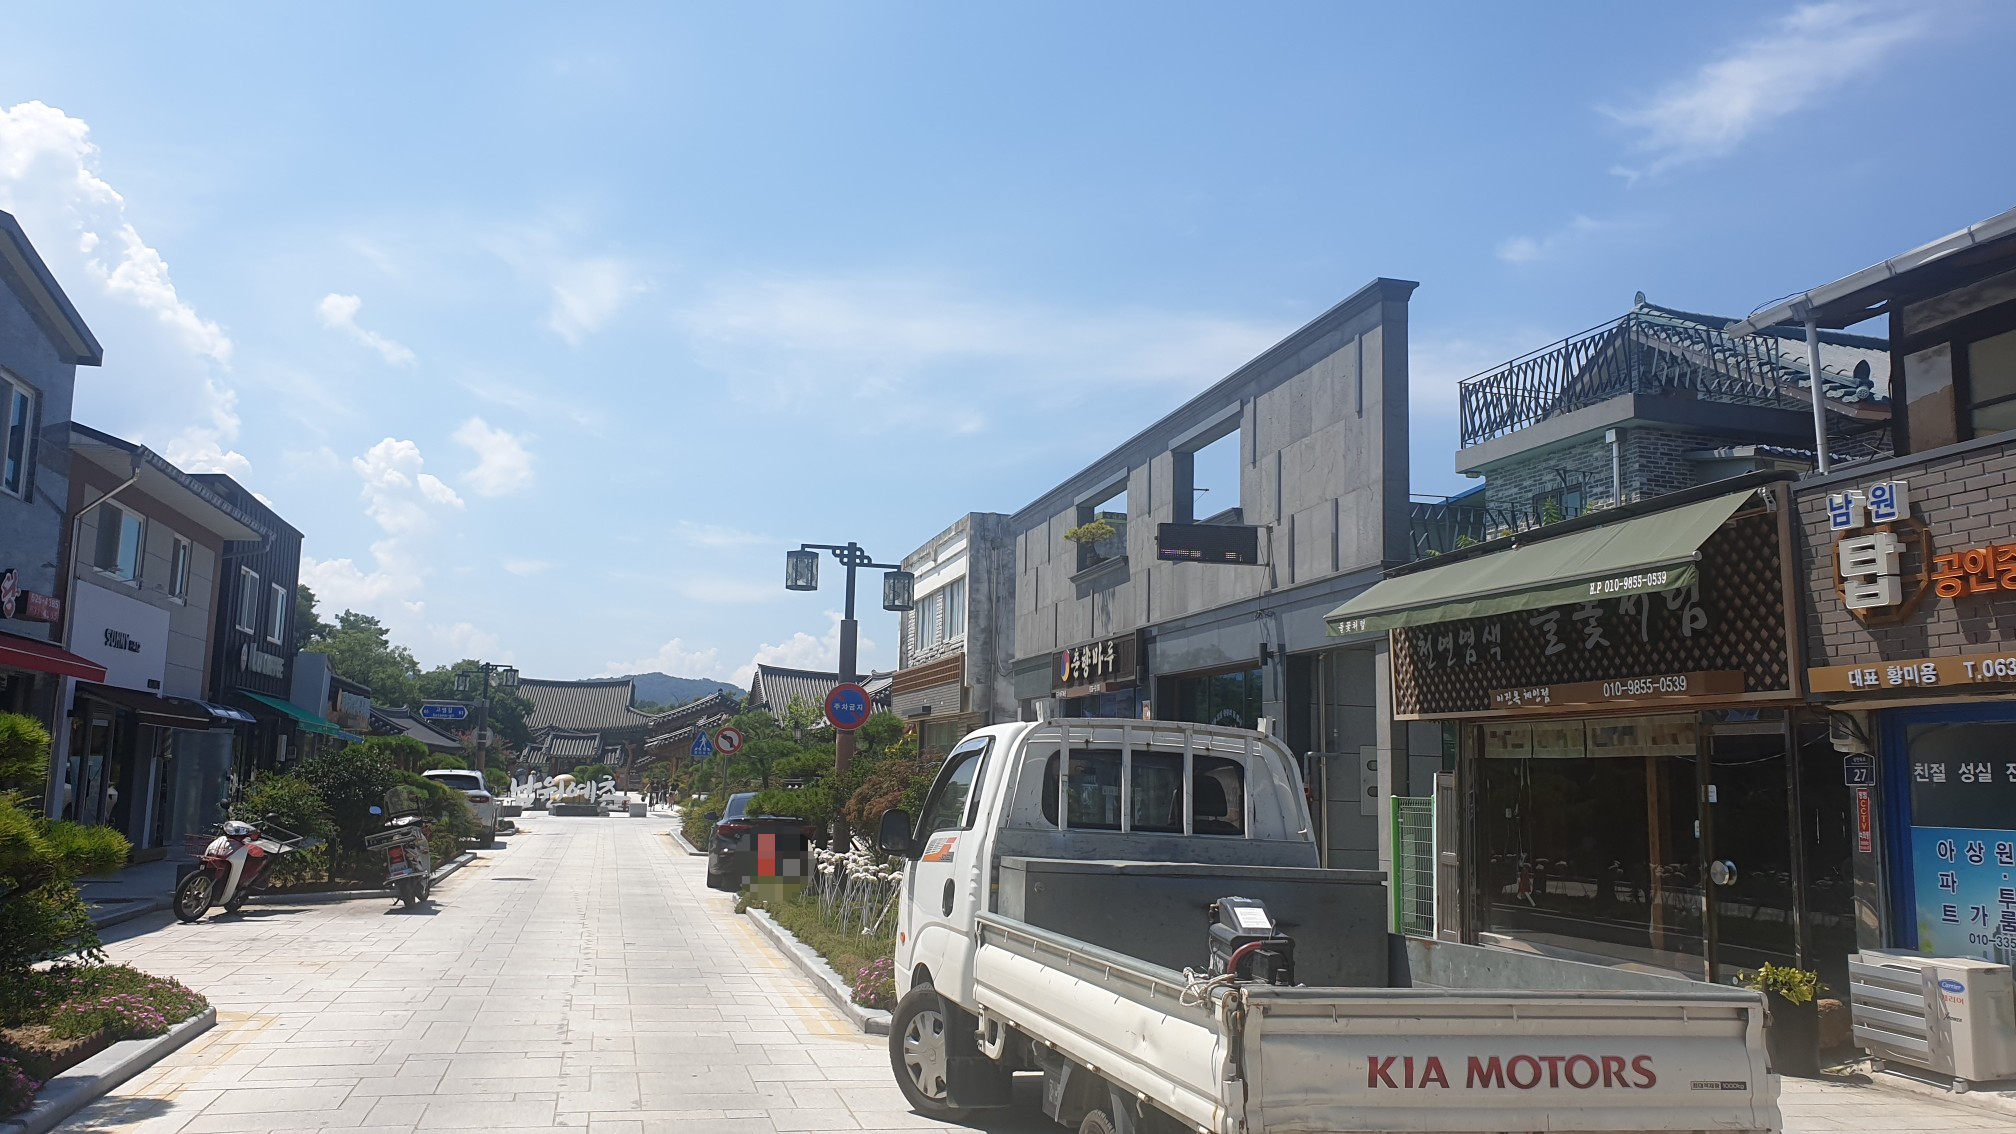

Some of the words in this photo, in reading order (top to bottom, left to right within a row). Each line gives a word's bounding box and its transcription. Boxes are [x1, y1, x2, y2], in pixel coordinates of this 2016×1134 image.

[1827, 482, 1899, 530] 남원
[1604, 571, 1667, 593] 010-9855-0539
[1839, 532, 1902, 609] 탑
[1070, 640, 1118, 679] 춘향마루
[1603, 675, 1687, 697] 010-9855-0539
[1848, 668, 1880, 688] 대표
[1887, 662, 1938, 686] 황미용
[833, 702, 864, 712] 주차금지
[1853, 768, 1867, 782] 27
[1913, 762, 1946, 783] 친절
[1958, 762, 1993, 783] 성실
[1936, 839, 1961, 925] 아파트
[1367, 1055, 1450, 1089] KIA
[1465, 1054, 1657, 1090] MOTORS
[1722, 1082, 1745, 1090] 1000kg
